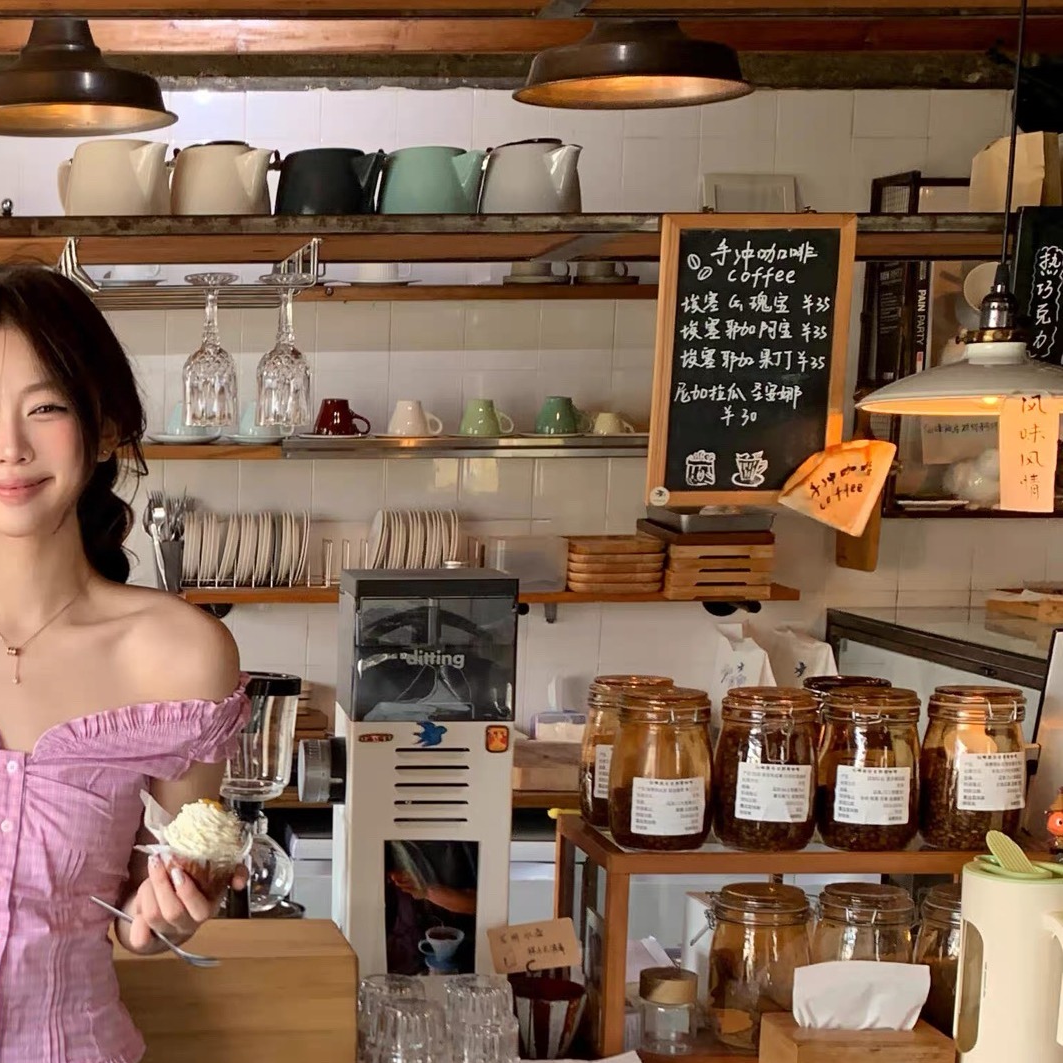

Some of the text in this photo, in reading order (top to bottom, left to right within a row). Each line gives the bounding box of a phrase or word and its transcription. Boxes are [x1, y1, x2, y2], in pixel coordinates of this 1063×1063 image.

[710, 238, 818, 271] 手冲咖啡
[727, 266, 796, 288] coffee
[917, 289, 927, 312] PAIN
[1033, 252, 1061, 349] 热巧克力
[916, 312, 926, 345] PARTY
[674, 382, 747, 404] 尼加拉瓜
[1020, 394, 1047, 500] 风味风情
[407, 650, 465, 669] ditting
